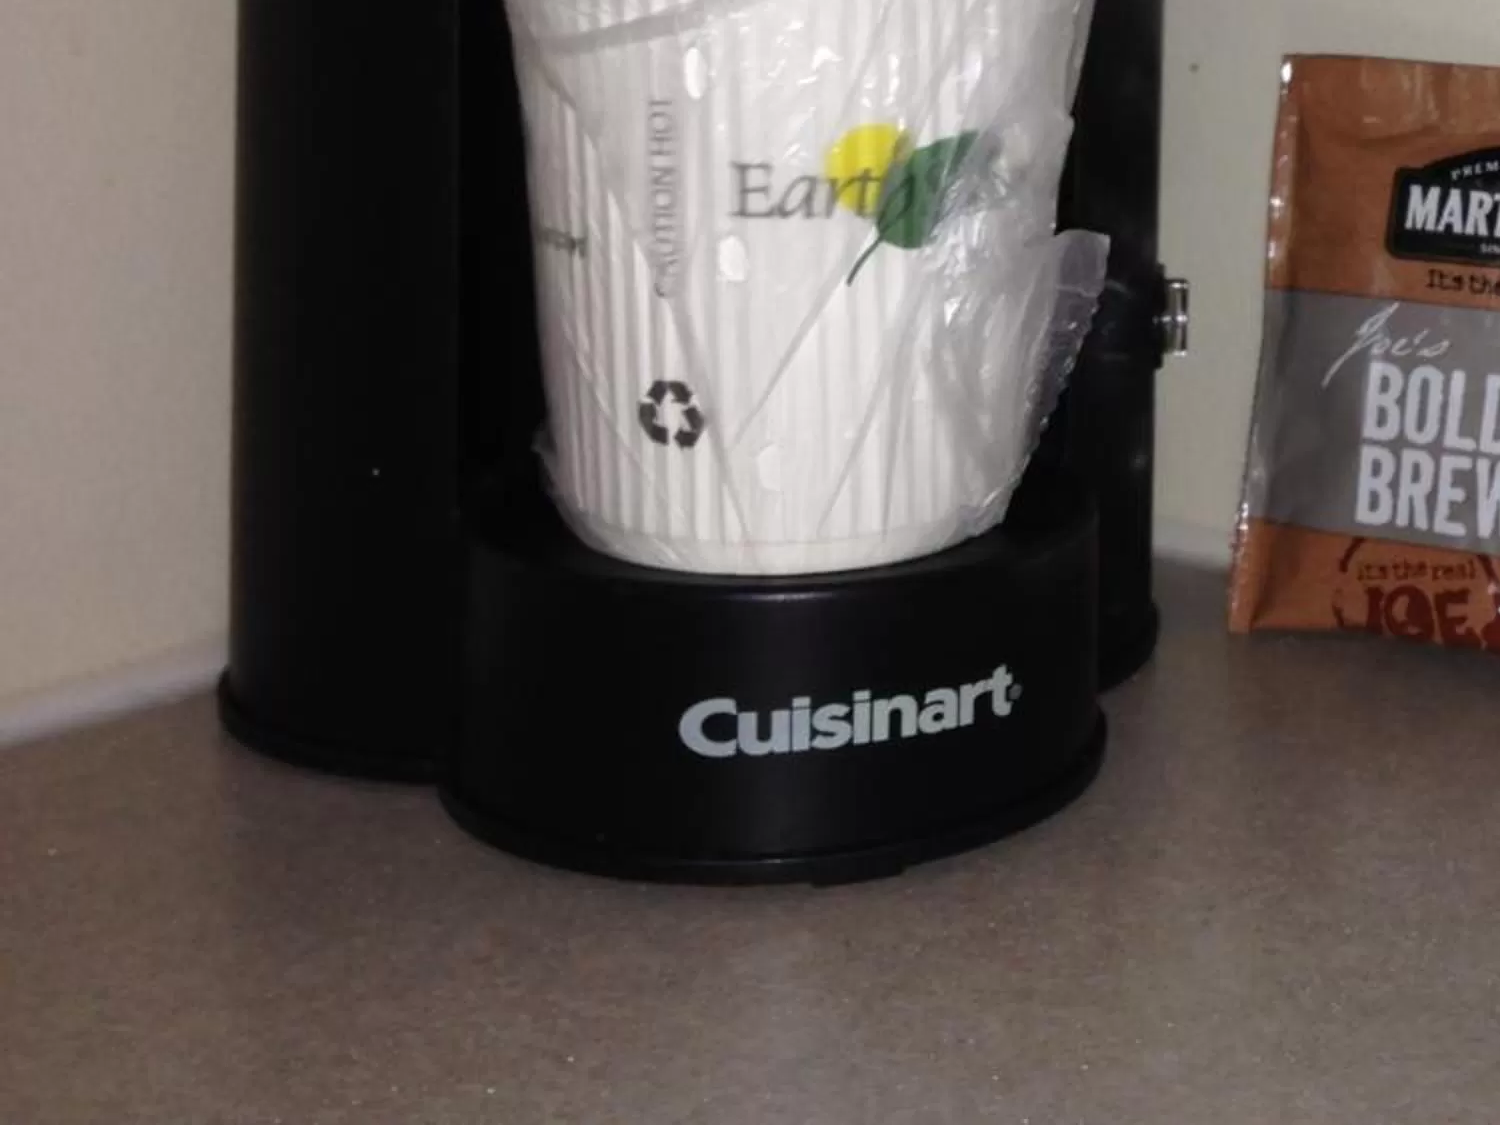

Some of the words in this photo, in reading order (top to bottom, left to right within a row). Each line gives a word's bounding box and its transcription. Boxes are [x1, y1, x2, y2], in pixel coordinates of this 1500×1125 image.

[649, 99, 676, 156] HOT
[1321, 302, 1450, 390] Joe's
[679, 664, 1013, 757] Cuisinart
